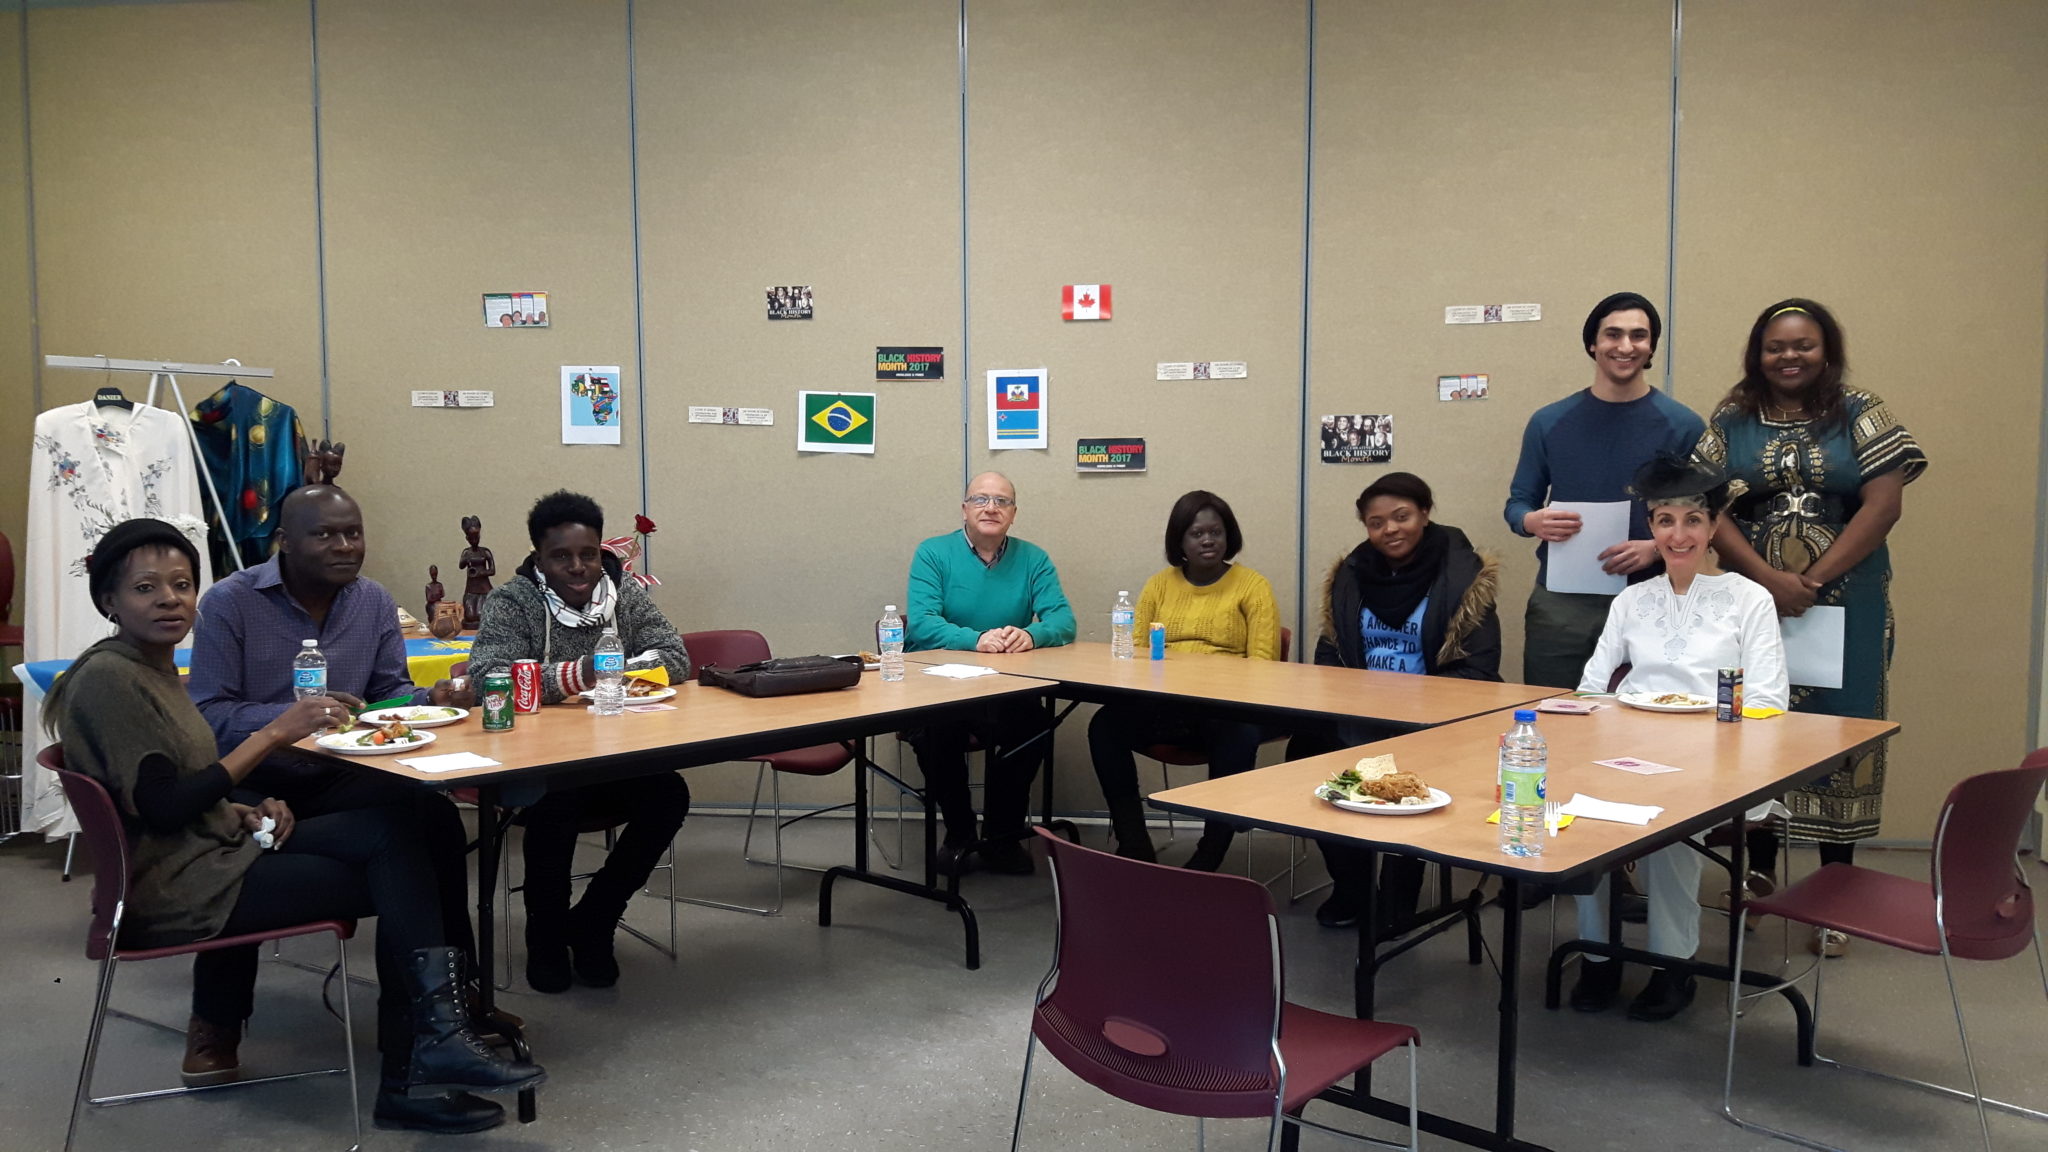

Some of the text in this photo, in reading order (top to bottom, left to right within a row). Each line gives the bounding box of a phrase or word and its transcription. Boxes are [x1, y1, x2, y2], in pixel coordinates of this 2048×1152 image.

[878, 353, 942, 363] BLACK HISTORY
[878, 362, 930, 371] MONTH 2017
[1079, 444, 1144, 454] BLACK HISTORY
[1353, 449, 1390, 457] HISTORY
[1078, 453, 1132, 463] MONTH 2017
[1367, 616, 1418, 636] ANOER
[1402, 640, 1416, 654] TO
[1367, 654, 1407, 672] MAKE A
